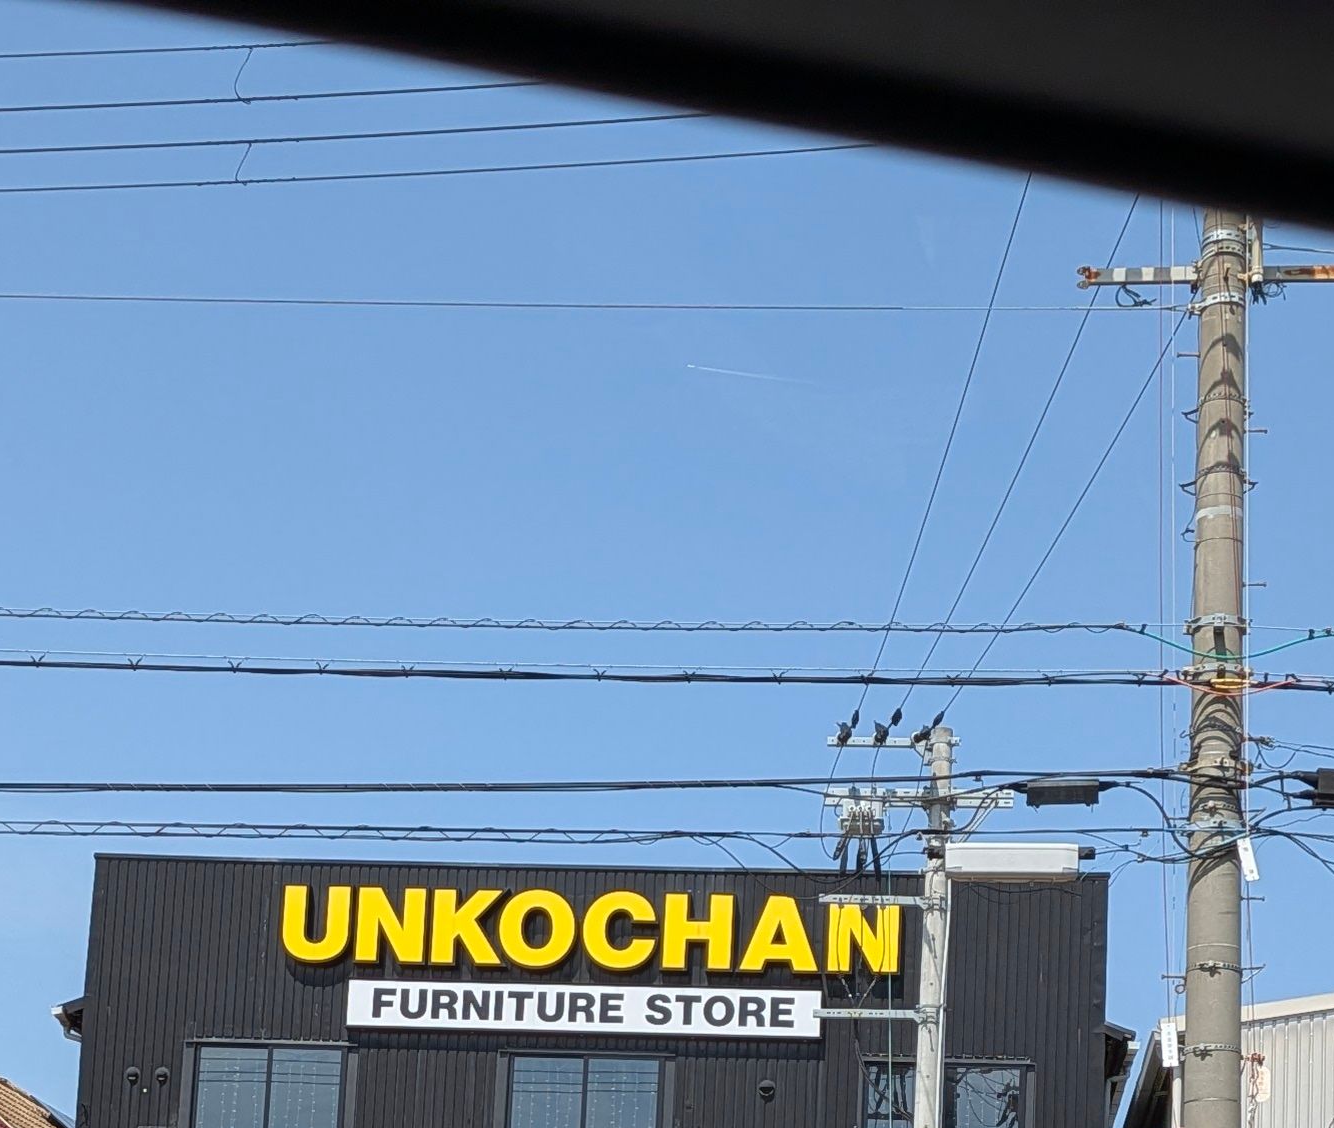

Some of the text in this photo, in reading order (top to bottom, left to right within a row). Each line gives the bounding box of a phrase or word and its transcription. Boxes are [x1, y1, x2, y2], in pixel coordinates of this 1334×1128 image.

[282, 884, 900, 976] UNKOCHAN
[371, 988, 795, 1028] FURNITURE STORE
